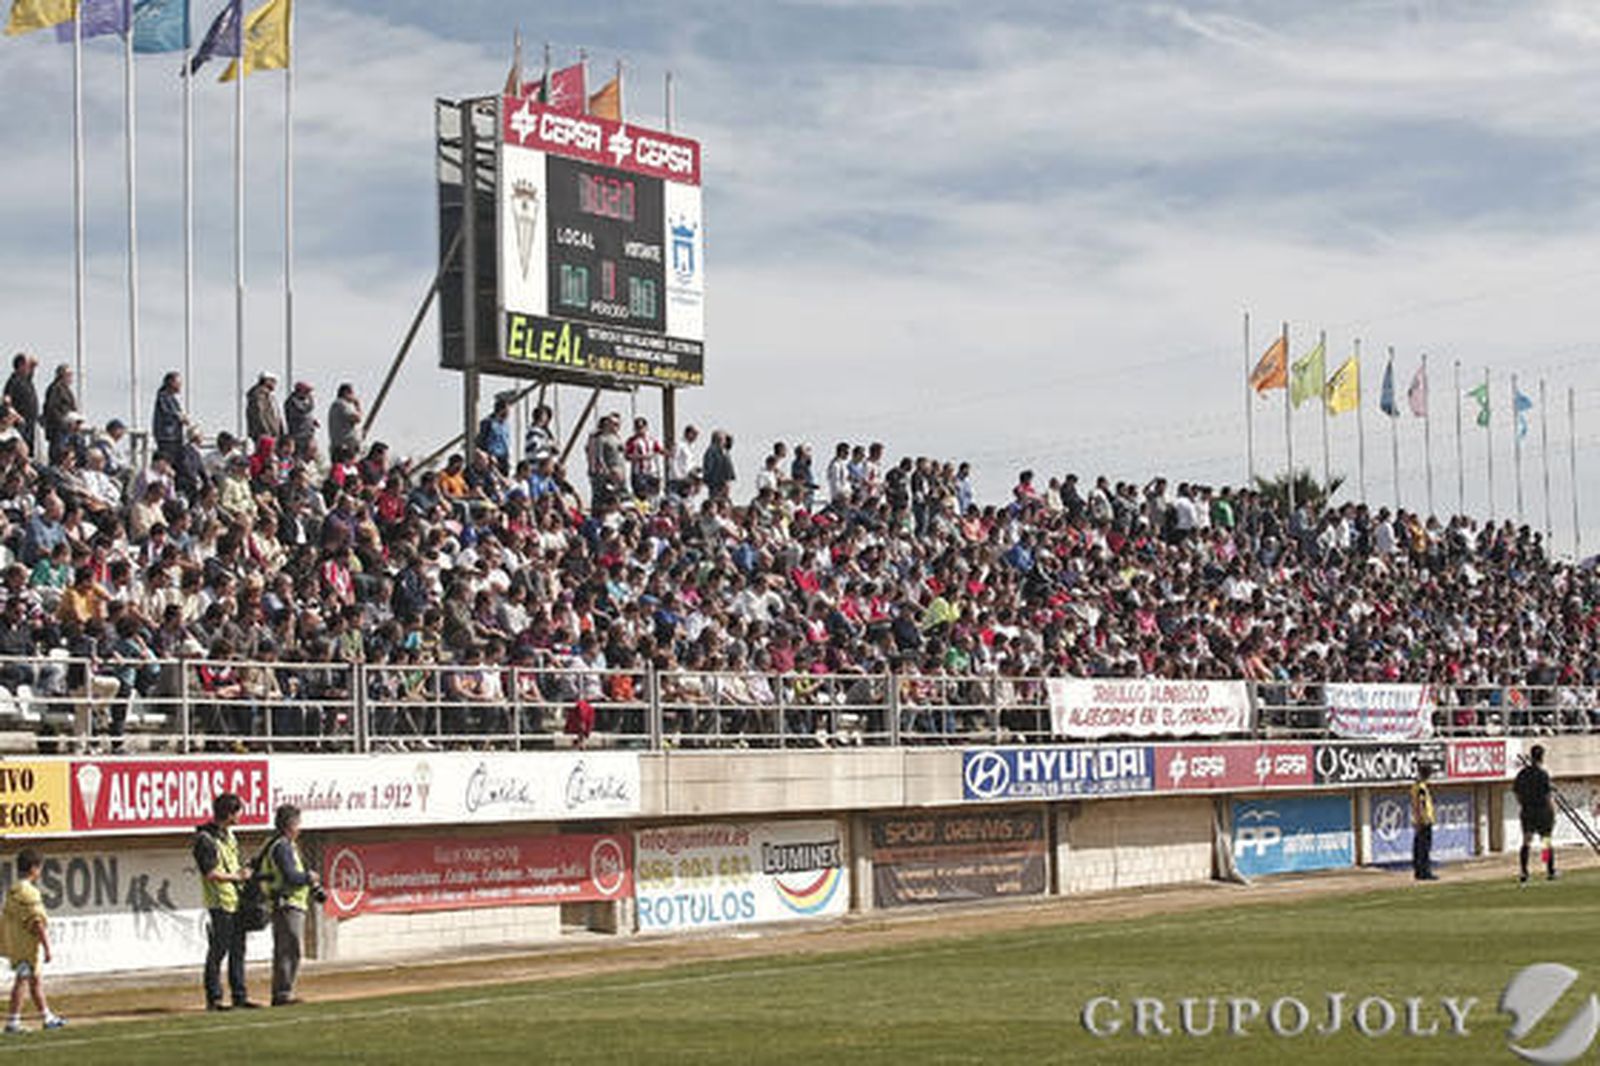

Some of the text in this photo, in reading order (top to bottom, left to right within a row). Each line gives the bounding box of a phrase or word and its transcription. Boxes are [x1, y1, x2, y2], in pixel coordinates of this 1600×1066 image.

[540, 113, 693, 174] CEPSA CEPSA
[556, 227, 595, 250] LOCAL
[1017, 748, 1146, 782] HYUNDAI
[370, 783, 413, 810] 1.912
[762, 841, 841, 874] LUMINEX
[637, 891, 756, 926] ROTULOS
